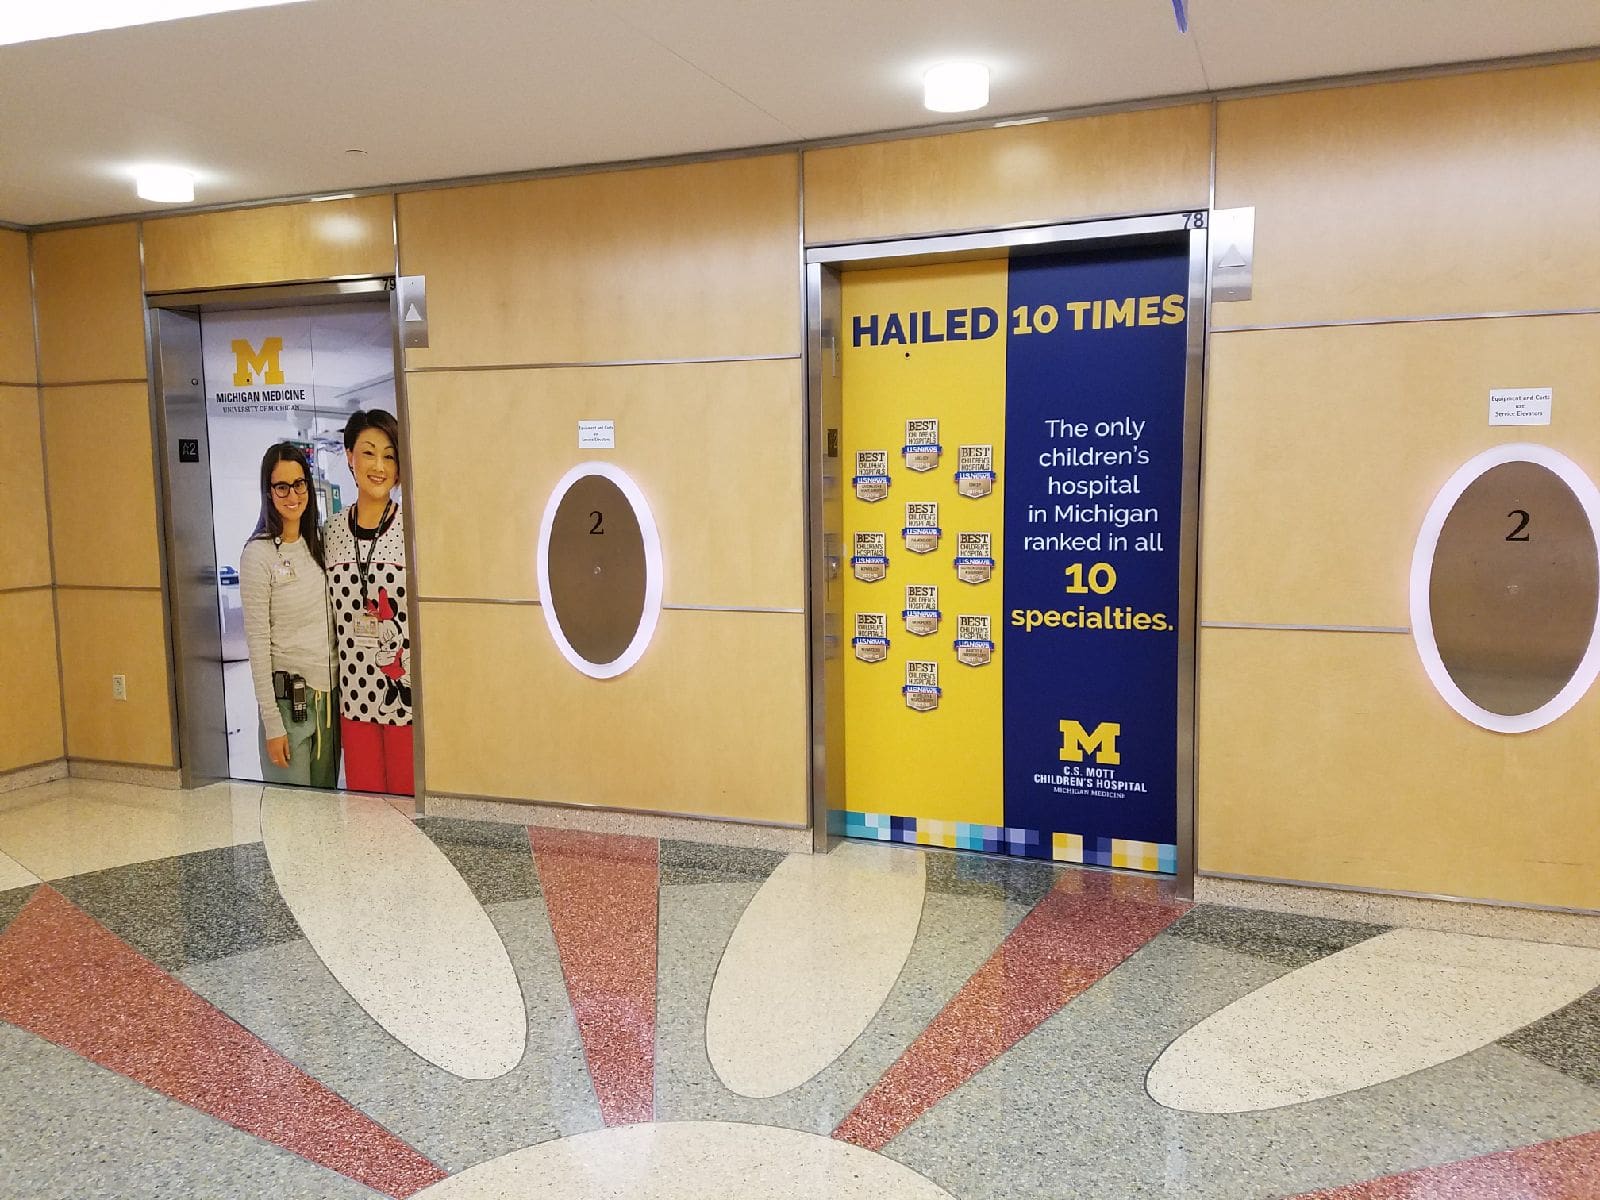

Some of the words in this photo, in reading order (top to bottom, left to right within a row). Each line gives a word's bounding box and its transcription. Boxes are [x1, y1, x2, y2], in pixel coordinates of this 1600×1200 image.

[1182, 212, 1203, 229] 78
[383, 279, 396, 290] 79
[852, 306, 999, 348] HAILED
[1013, 304, 1058, 335] 10
[1066, 294, 1186, 331] TIMES
[231, 336, 285, 387] M
[216, 392, 259, 403] MICHIGAN
[262, 390, 306, 401] MEDICINE
[908, 421, 936, 431] BEST
[1045, 418, 1088, 438] The
[1094, 416, 1145, 440] only
[858, 452, 885, 462] BEST
[961, 447, 990, 456] BEST
[1048, 474, 1141, 498] hospital
[908, 504, 936, 513] BEST
[1028, 504, 1047, 523] in
[1054, 504, 1158, 527] Michigan
[589, 510, 604, 535] 2
[1505, 509, 1530, 541] 2
[856, 533, 883, 543] BEST
[960, 534, 989, 543] BEST
[1024, 532, 1101, 551] ranked
[1108, 532, 1128, 551] in
[1134, 532, 1164, 551] all
[1065, 562, 1117, 595] 10
[908, 586, 935, 596] BEST
[857, 614, 884, 624] BEST
[960, 616, 988, 626] BEST
[1011, 605, 1175, 632] specialties.
[908, 663, 936, 672] BEST
[1059, 719, 1120, 765] M
[1063, 766, 1083, 776] C.S.
[1086, 767, 1115, 779] MOTT
[1033, 774, 1093, 788] CHILDREN'S
[1096, 779, 1148, 792] HOSPITAL
[1053, 786, 1089, 795] MICHIGAN
[1090, 789, 1126, 799] MEDICINE
